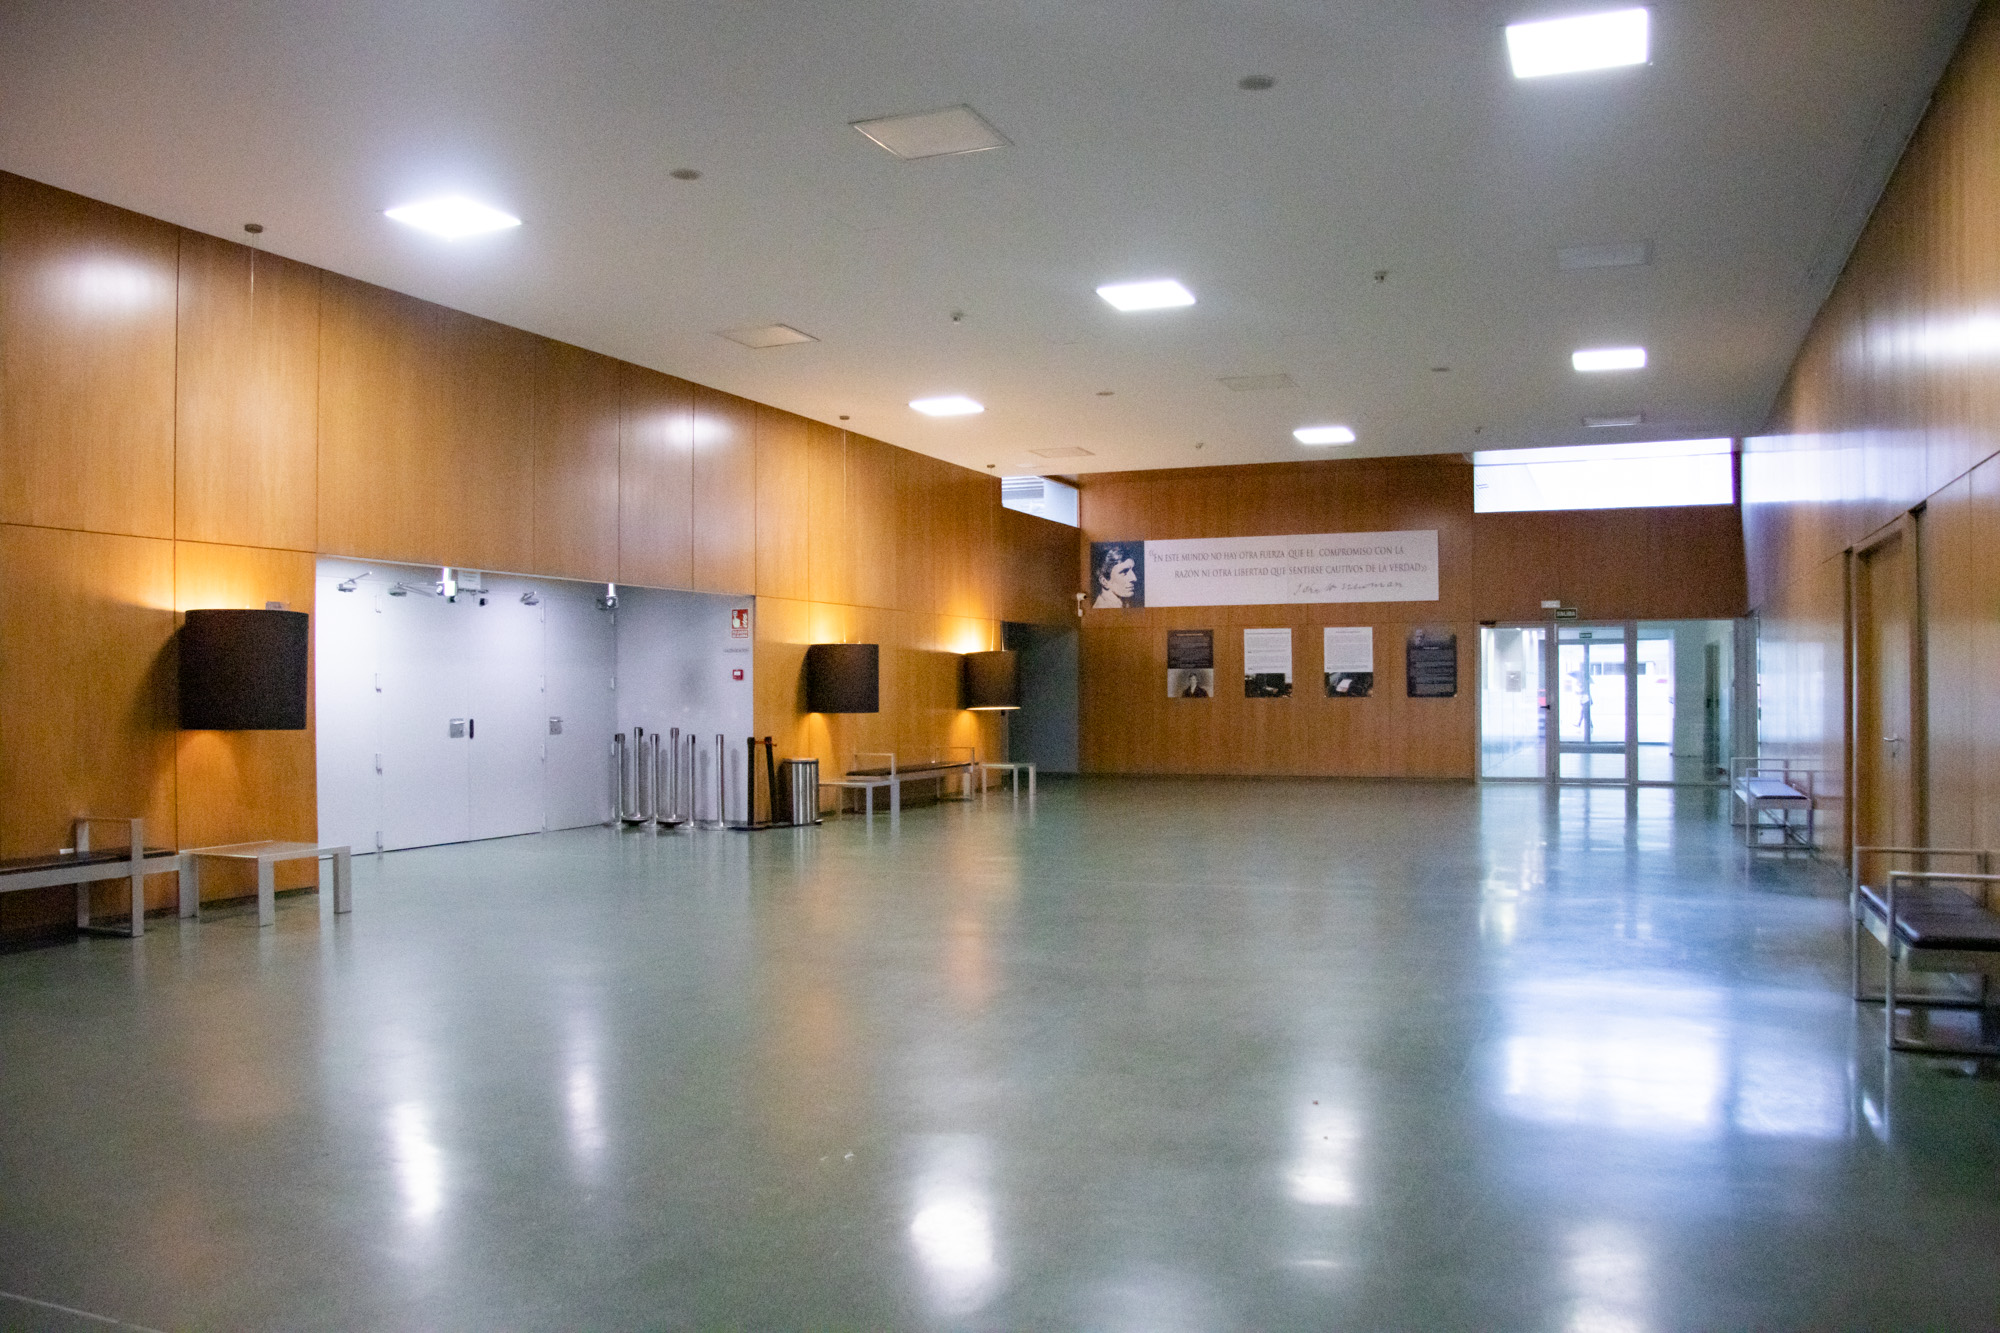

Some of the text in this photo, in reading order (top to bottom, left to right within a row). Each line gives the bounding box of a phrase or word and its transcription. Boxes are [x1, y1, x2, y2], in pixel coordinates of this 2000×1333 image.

[1165, 553, 1180, 562] ESTE
[1181, 552, 1209, 561] MUNDO
[1211, 552, 1222, 561] NO
[1223, 551, 1237, 560] HAY
[1239, 550, 1258, 560] OTRA
[1259, 549, 1285, 559] FUERZA
[1288, 548, 1304, 559] QUE
[1306, 548, 1314, 557] EL
[1318, 546, 1373, 557] COMPROMISO
[1374, 545, 1393, 555] CON
[1395, 545, 1405, 555] LA
[1174, 567, 1199, 578] RAZÓN
[1201, 568, 1210, 578] NI
[1212, 568, 1232, 577] OTRA
[1234, 567, 1269, 577] LIBERTAD
[1270, 566, 1287, 577] QUE
[1289, 565, 1323, 575] SENTIRSE
[1325, 564, 1363, 574] CAUTIVOS
[1366, 564, 1377, 573] DE
[1378, 563, 1387, 573] LA
